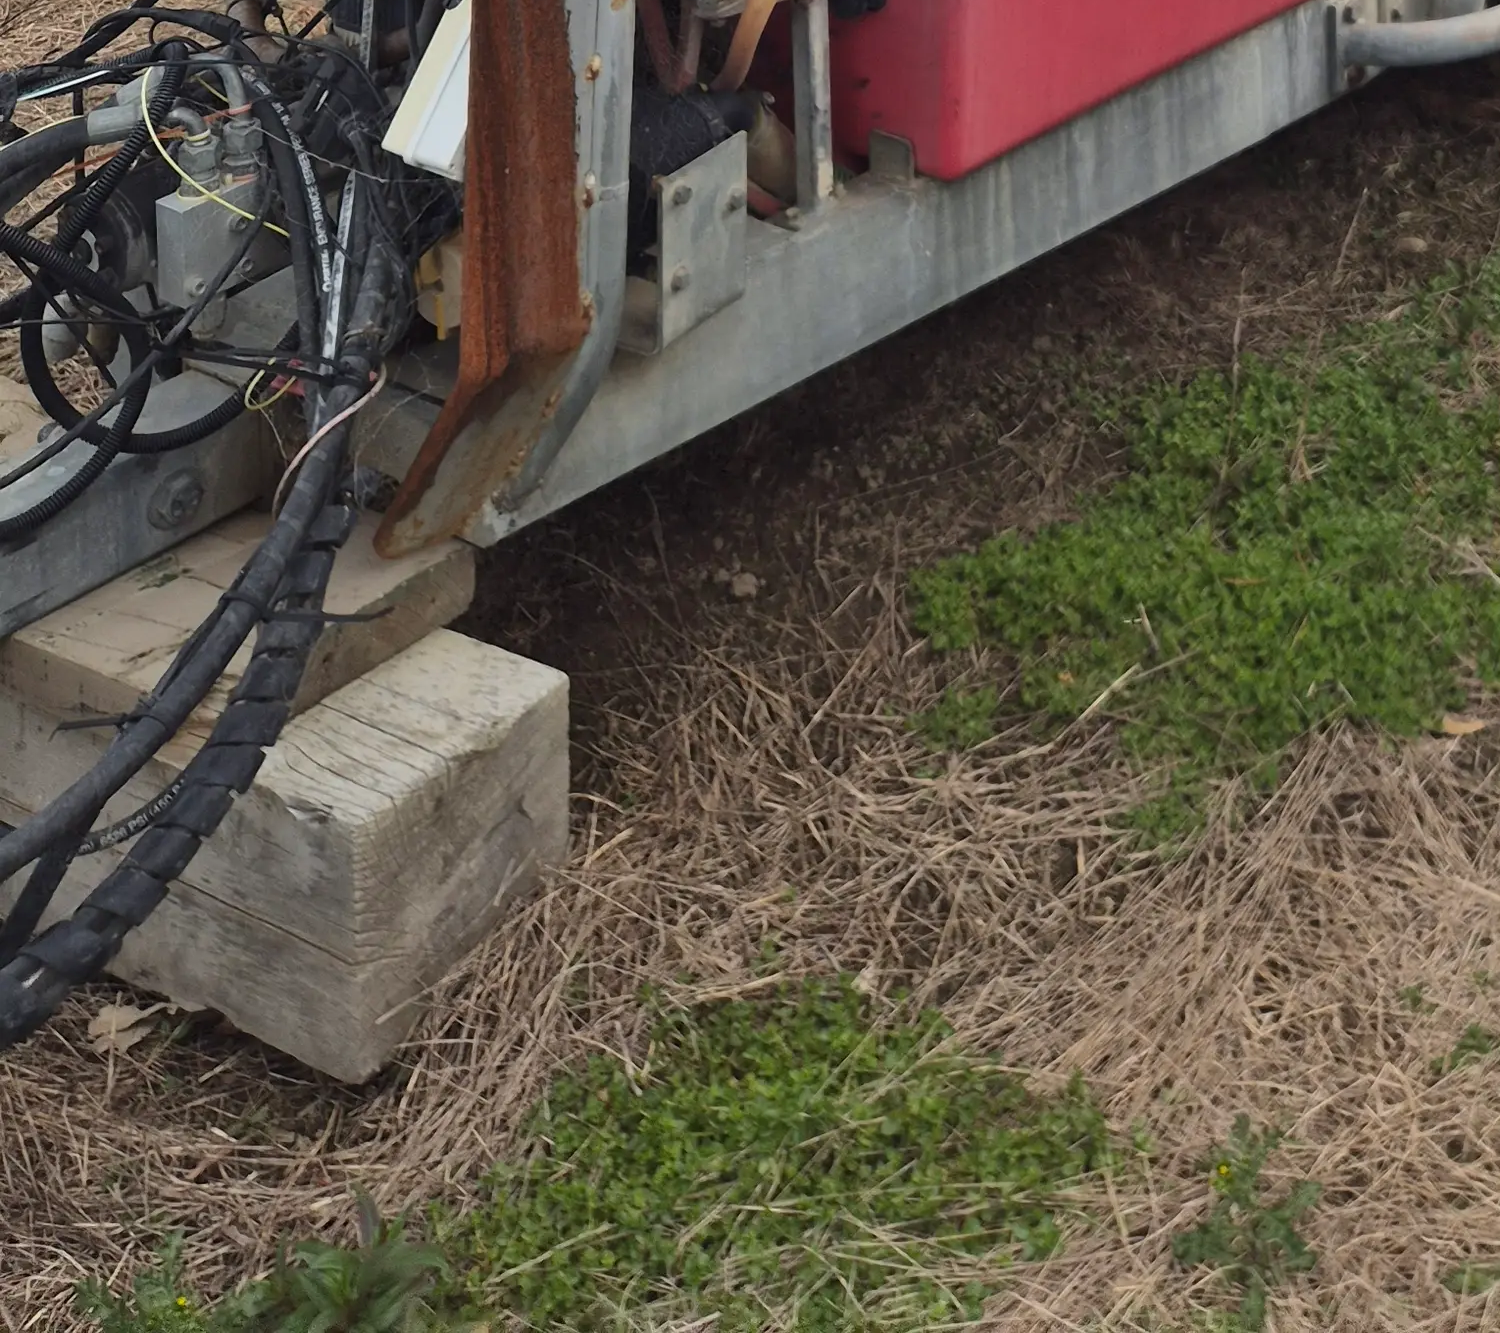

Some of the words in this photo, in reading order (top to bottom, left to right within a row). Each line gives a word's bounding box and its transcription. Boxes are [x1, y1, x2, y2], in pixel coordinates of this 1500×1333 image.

[298, 151, 316, 186] SERIES
[306, 185, 329, 246] ENDURANCE
[127, 813, 149, 832] PSI
